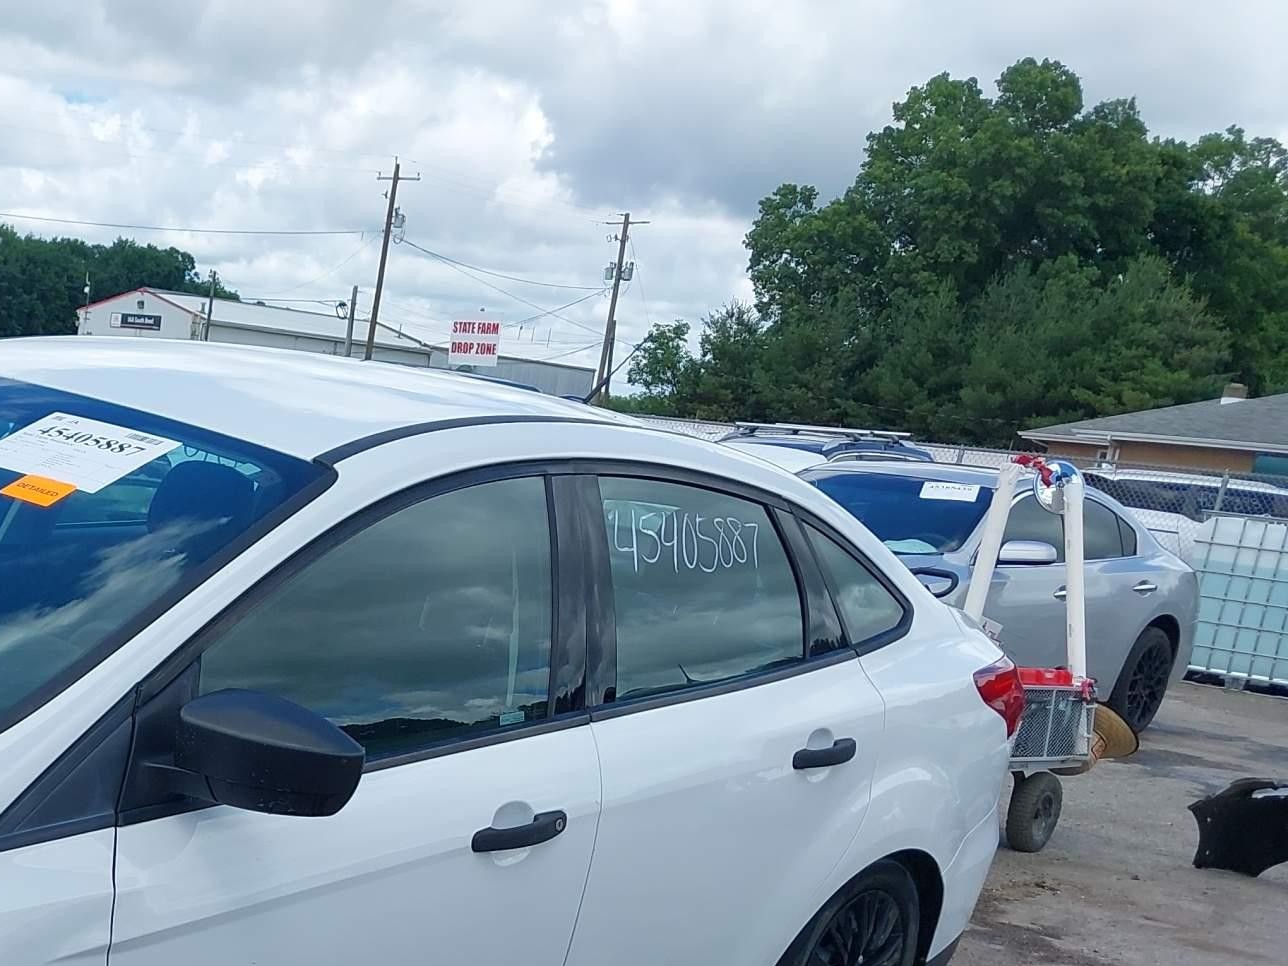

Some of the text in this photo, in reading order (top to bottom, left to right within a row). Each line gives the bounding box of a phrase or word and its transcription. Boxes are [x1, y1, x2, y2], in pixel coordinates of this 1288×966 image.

[453, 321, 499, 335] STATE FARM
[451, 341, 497, 355] DROP ZONE
[38, 425, 146, 457] 45405887
[16, 482, 59, 498] DETAILED
[614, 509, 758, 573] 45405887
